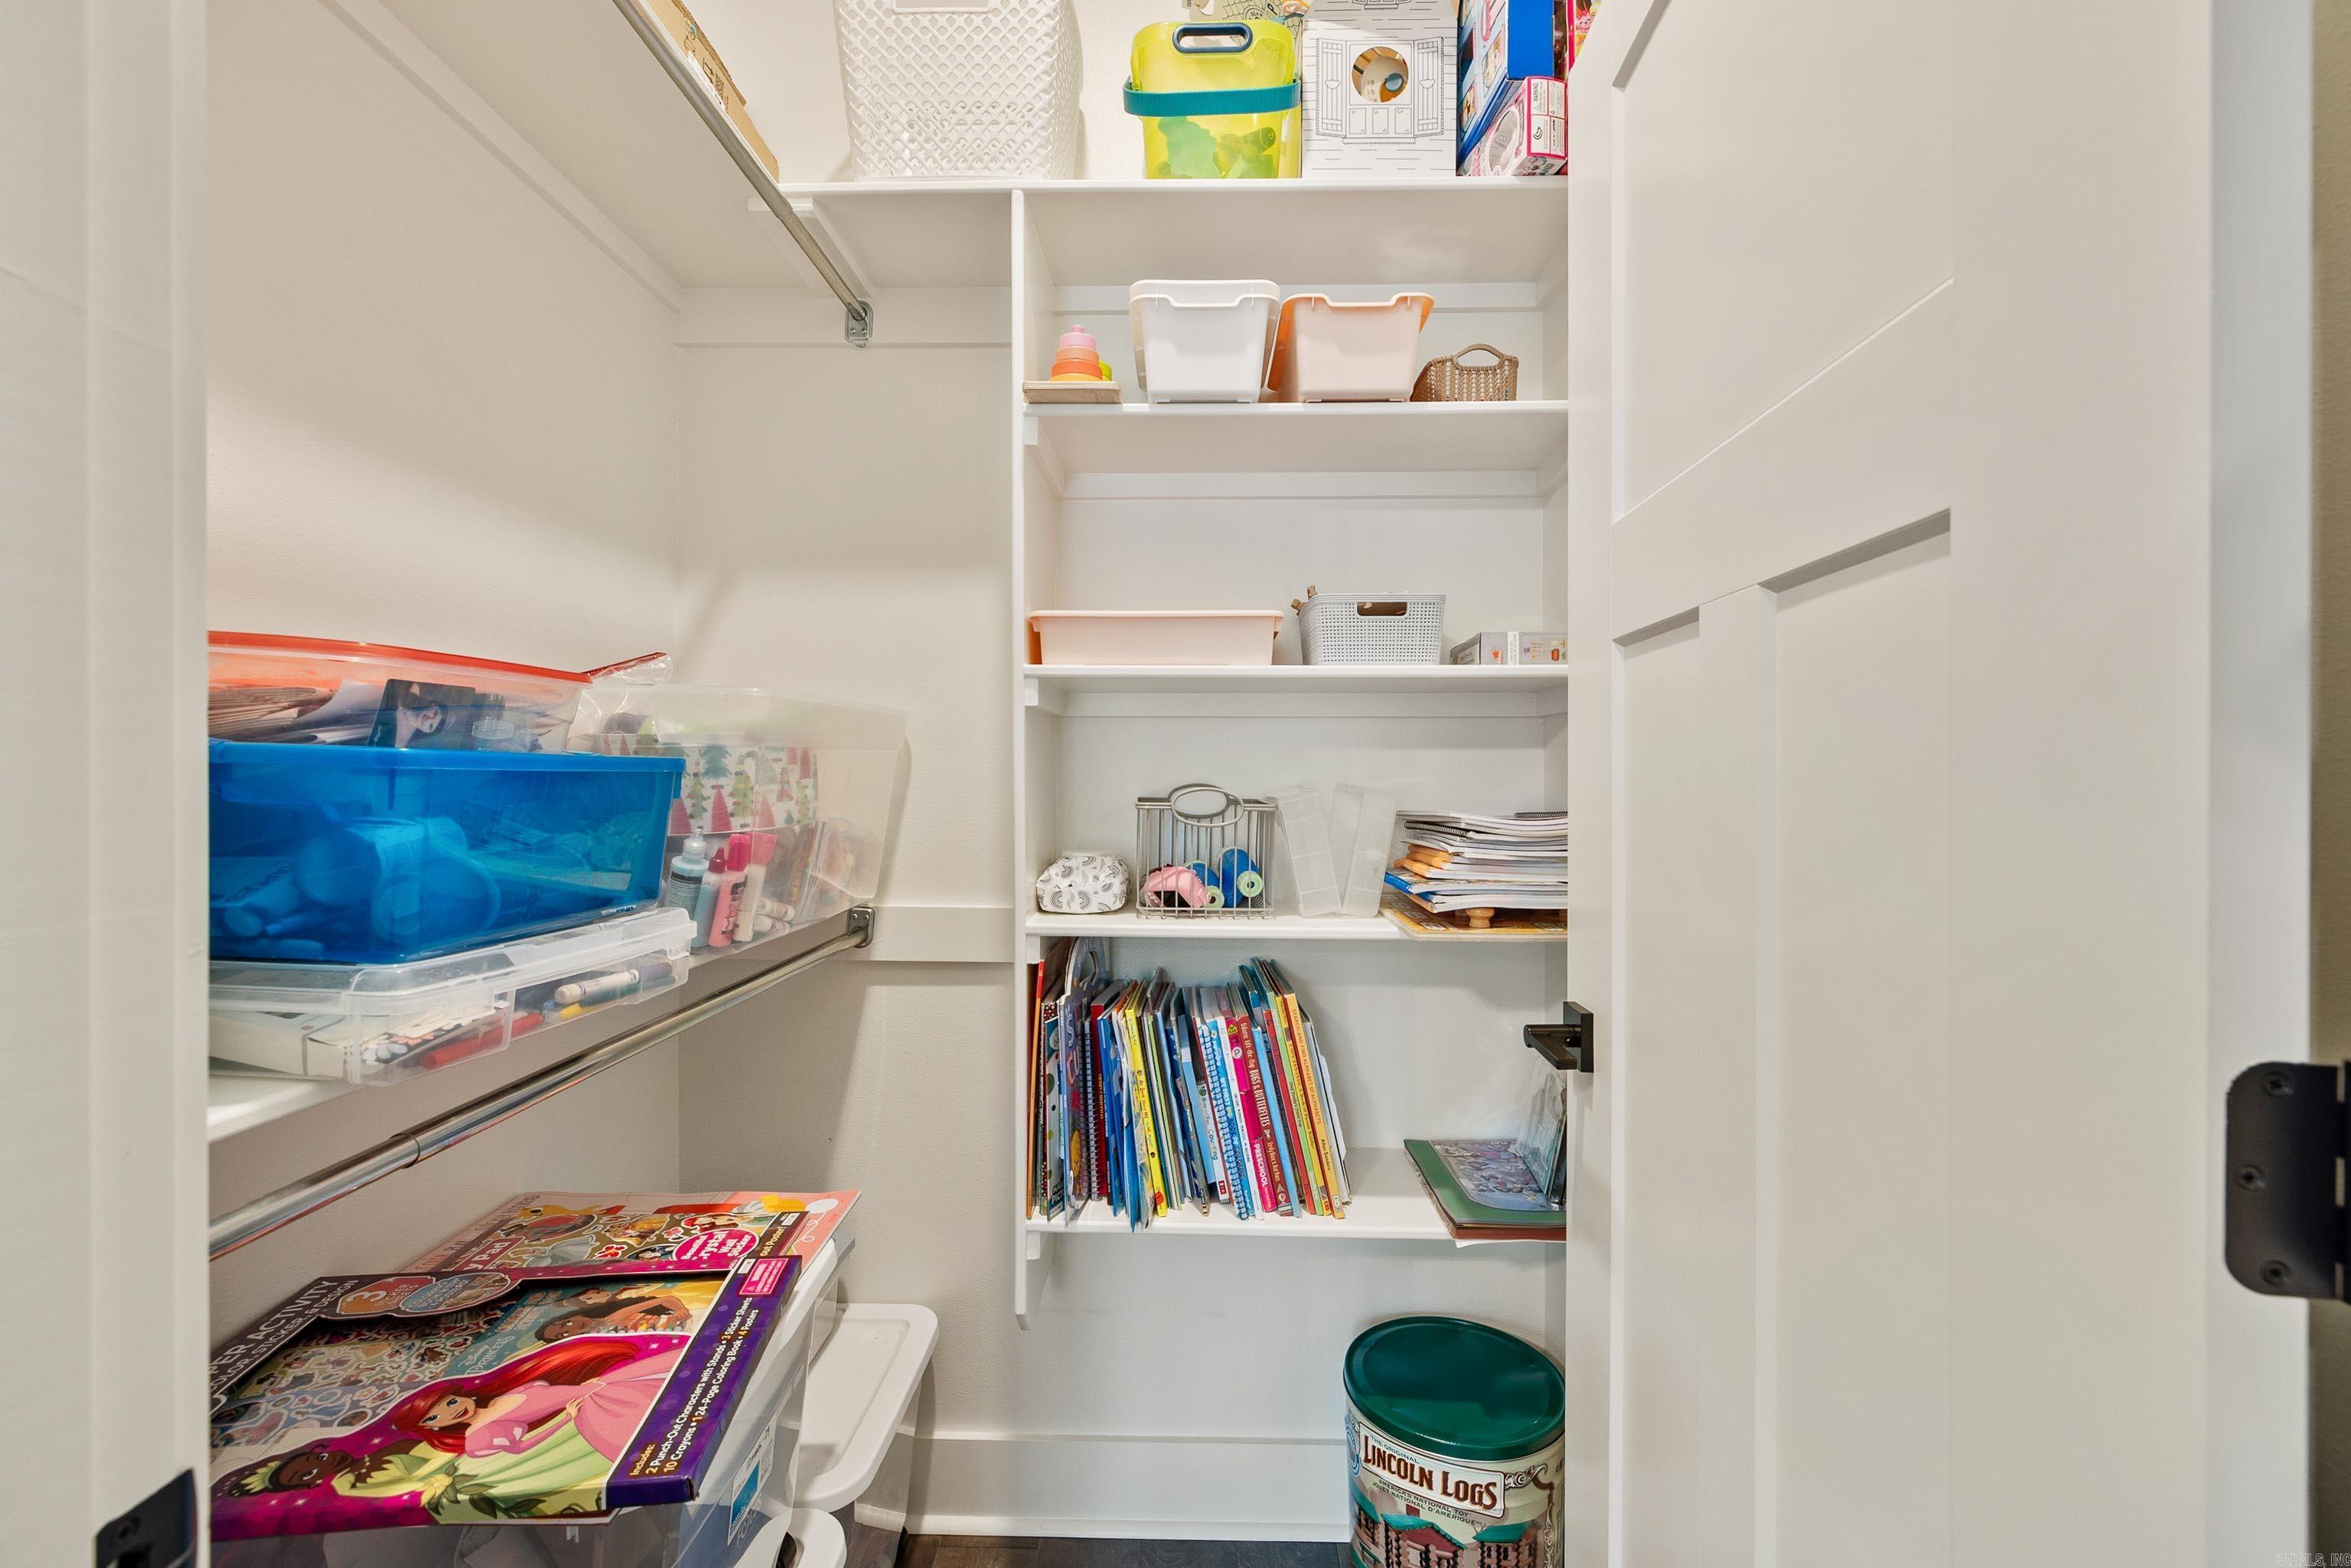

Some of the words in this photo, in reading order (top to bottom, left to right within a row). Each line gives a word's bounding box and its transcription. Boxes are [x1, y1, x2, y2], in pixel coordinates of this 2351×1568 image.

[1250, 1068, 1260, 1084] BUGS
[1255, 1088, 1270, 1127] BUTTERFLIES
[1303, 1058, 1313, 1086] ALPHABET
[1310, 1093, 1321, 1125] ALPHABETS
[1207, 1128, 1218, 1160] Counting
[1234, 1145, 1245, 1179] COLORING
[1254, 1143, 1267, 1188] PRESCHOOL
[477, 1241, 510, 1261] Pad
[698, 1231, 729, 1260] rystal
[727, 1234, 752, 1257] Sticker
[318, 1280, 359, 1309] DESIGN
[348, 1290, 386, 1304] 3
[735, 1298, 753, 1317] Sheets
[253, 1280, 338, 1340] ACTIVITY
[744, 1309, 759, 1332] Posters
[726, 1315, 742, 1336] Sticker
[709, 1345, 726, 1368] Stands
[726, 1339, 743, 1360] Book
[700, 1361, 714, 1387] with
[711, 1356, 735, 1390] Coloring
[676, 1380, 706, 1428] Characters
[695, 1388, 718, 1416] 24-Page
[650, 1423, 682, 1466] Punch-Out
[670, 1426, 696, 1461] Crayons
[1370, 1436, 1384, 1447] THE
[1384, 1444, 1420, 1464] ORIGINAL
[630, 1444, 655, 1475] Includes:
[646, 1466, 657, 1475] 2
[664, 1457, 677, 1472] 10
[1363, 1435, 1433, 1491] LINCOLN
[1440, 1470, 1497, 1511] LOGS
[1371, 1481, 1391, 1494] JOUET
[1391, 1491, 1426, 1509] NATIONAL
[1378, 1479, 1413, 1498] AMERICA'S
[1414, 1495, 1454, 1514] NATIONAL
[1454, 1509, 1469, 1517] TOY
